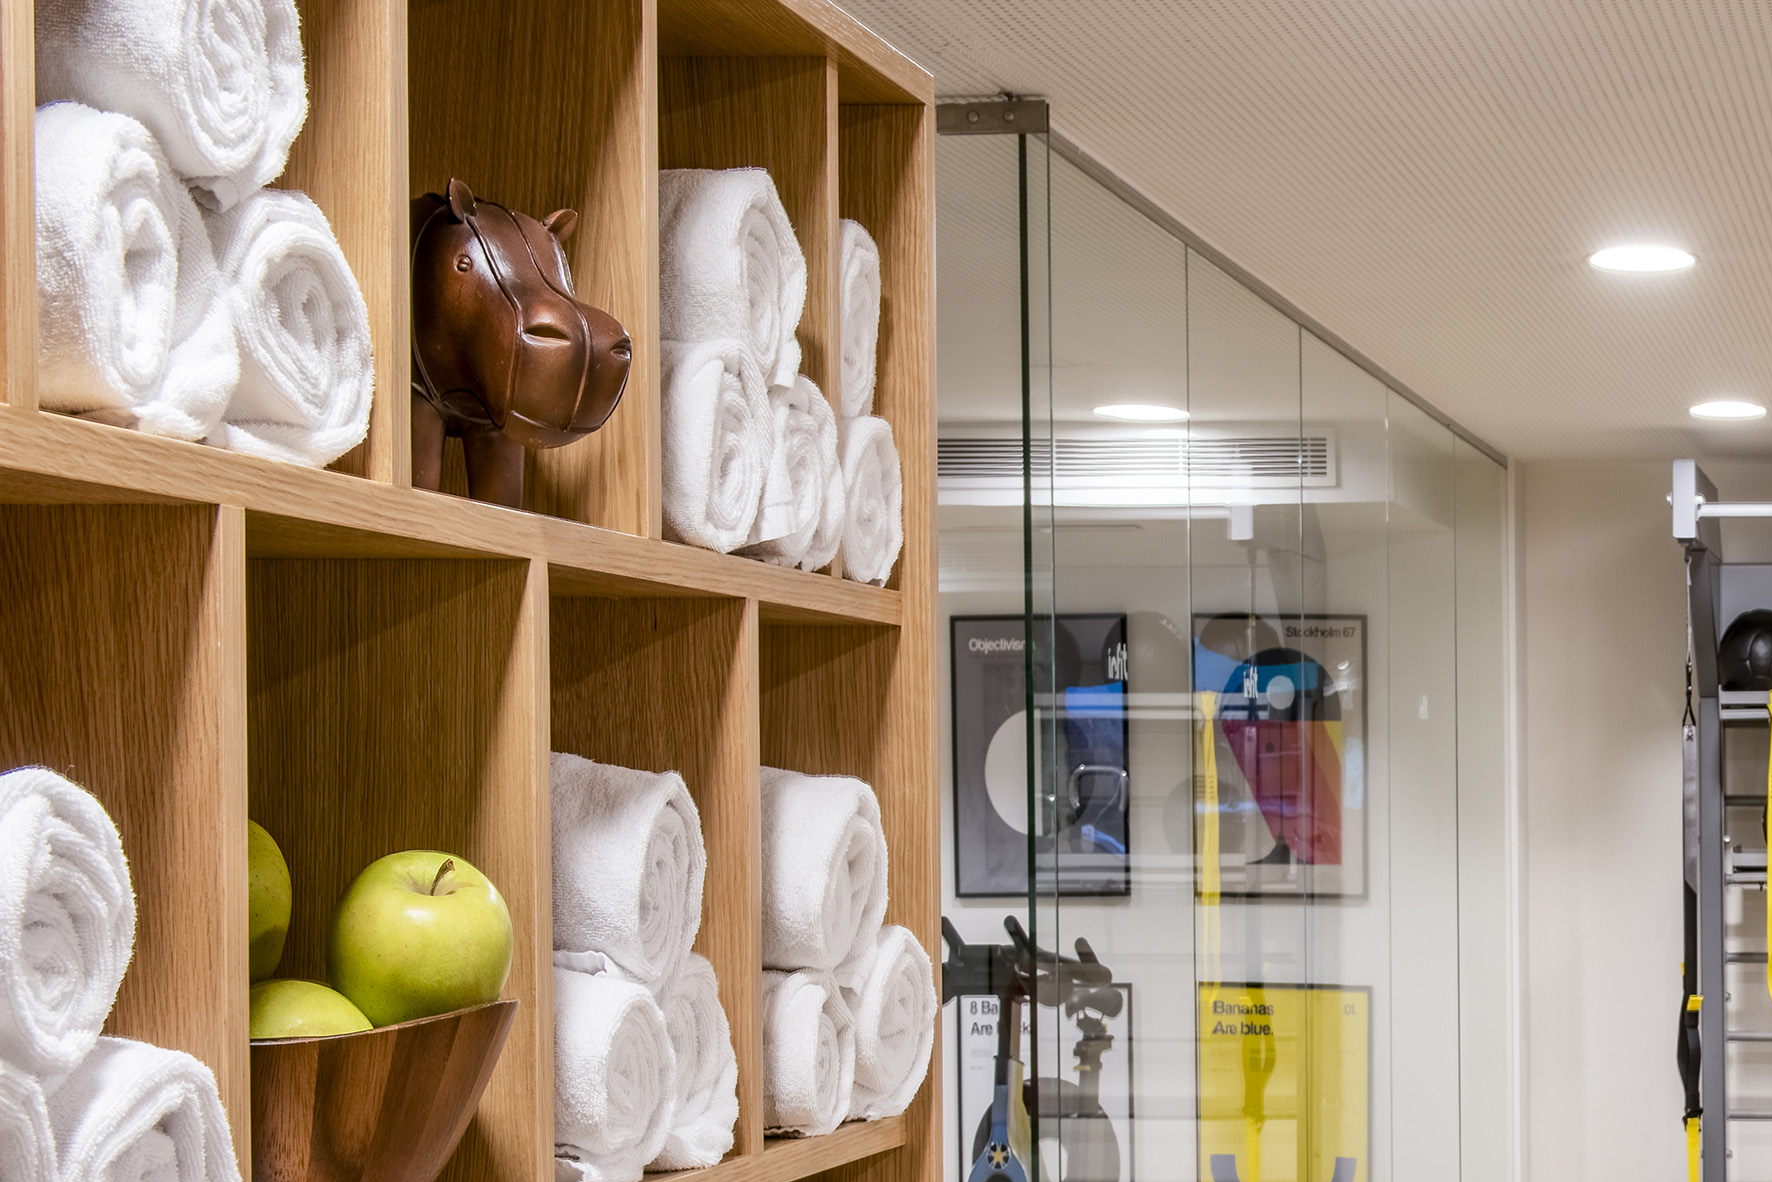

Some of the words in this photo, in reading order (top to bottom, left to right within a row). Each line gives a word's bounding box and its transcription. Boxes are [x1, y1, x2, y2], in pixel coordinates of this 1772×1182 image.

[1285, 626, 1341, 638] Stockholm
[1342, 626, 1356, 638] 67
[970, 1000, 978, 1015] 8
[1212, 1000, 1274, 1016] Bananas
[970, 1021, 993, 1036] Are
[1212, 1020, 1238, 1035] Are
[1240, 1021, 1274, 1036] blue.
